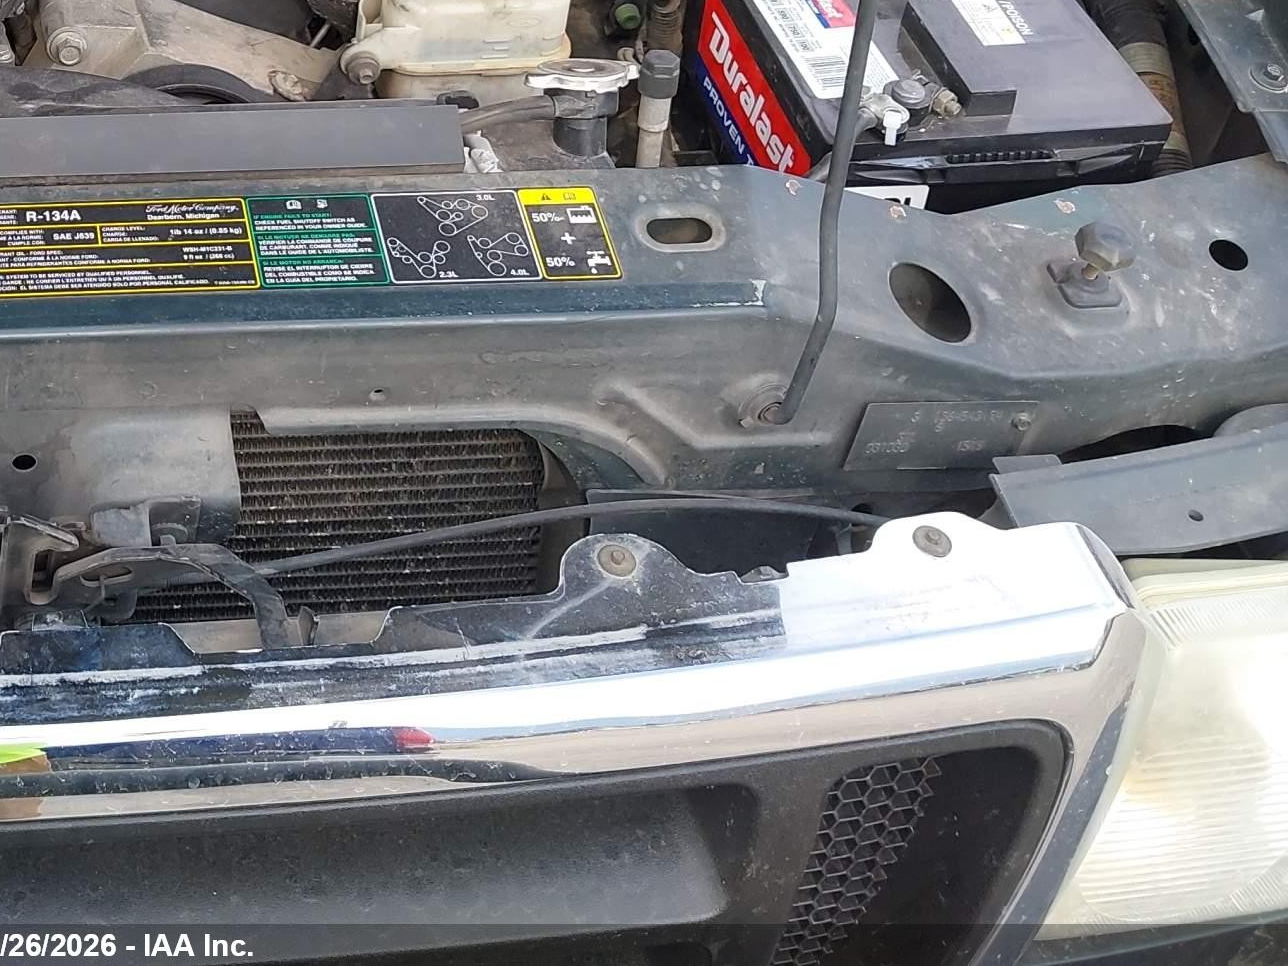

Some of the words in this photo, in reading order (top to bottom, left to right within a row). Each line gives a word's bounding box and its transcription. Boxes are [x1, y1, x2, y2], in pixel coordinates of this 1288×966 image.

[711, 10, 795, 174] Duralast
[703, 75, 744, 155] PROVEN
[146, 204, 167, 213] Ford
[167, 204, 193, 214] Motor
[25, 209, 82, 222] R-134A
[185, 212, 220, 220] Michigan
[228, 227, 243, 236] kg)
[546, 257, 575, 267] 50%
[439, 270, 459, 278] 2.3L
[510, 268, 530, 276] 4.0L
